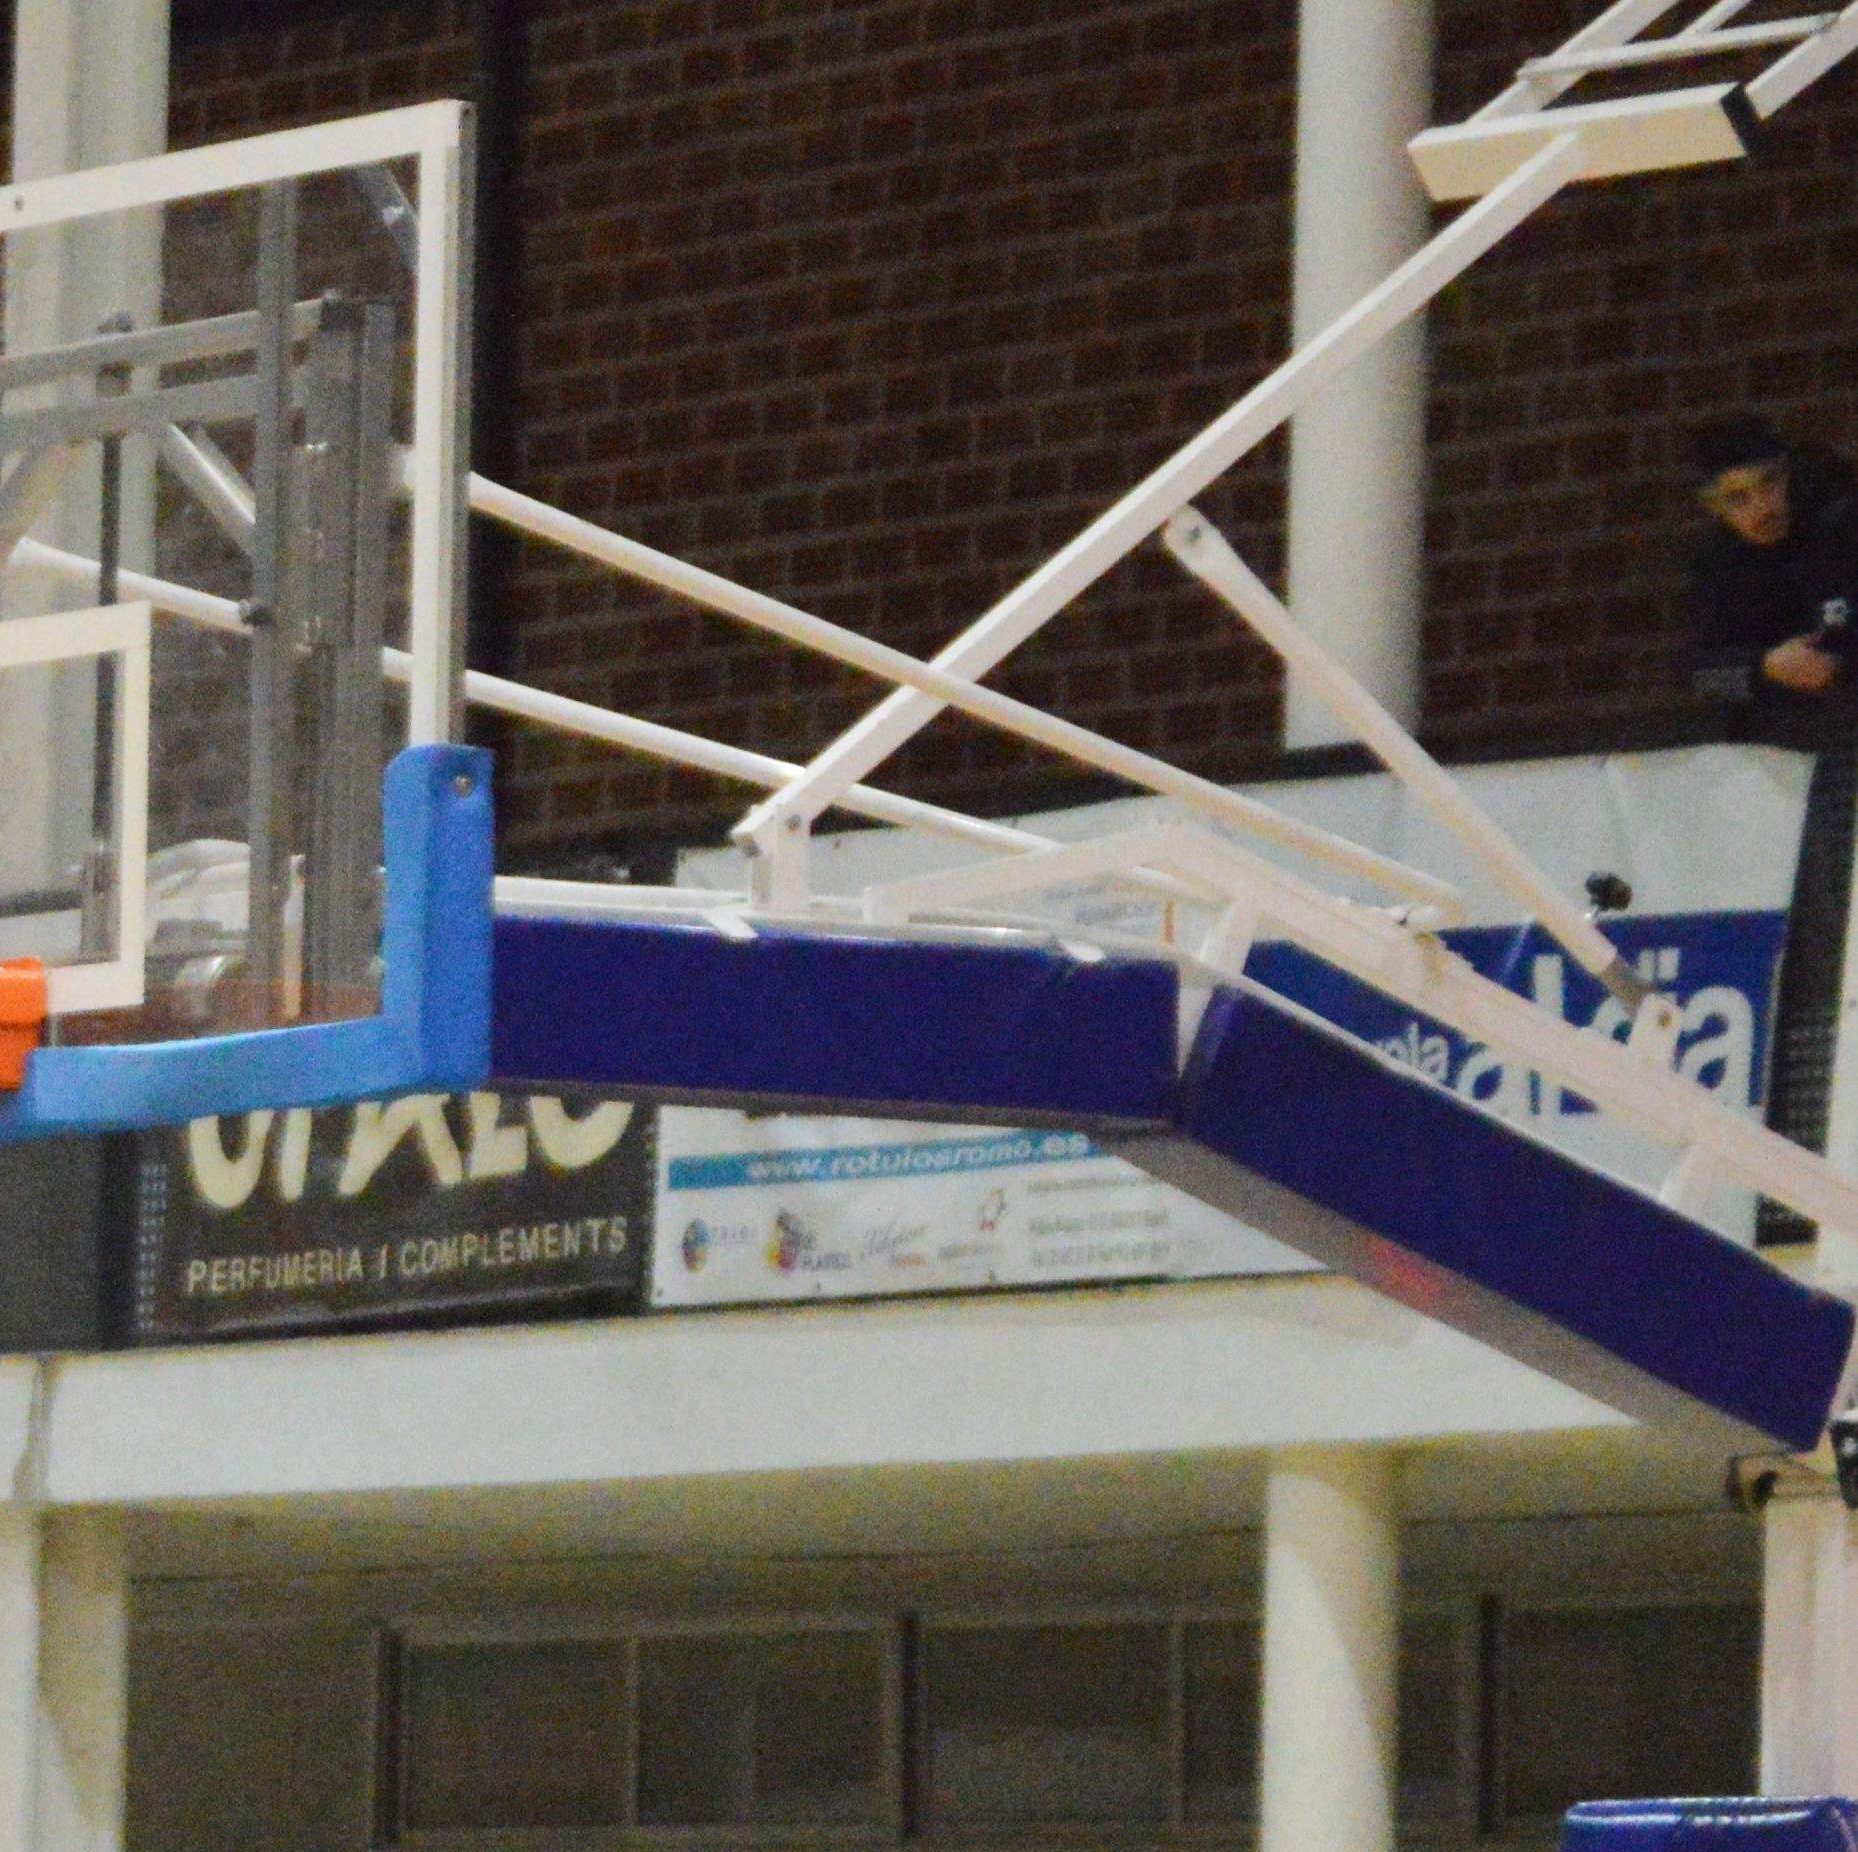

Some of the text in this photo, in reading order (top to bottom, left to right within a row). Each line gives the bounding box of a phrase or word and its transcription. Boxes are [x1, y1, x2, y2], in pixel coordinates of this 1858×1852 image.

[1374, 1022, 1448, 1082] ola
[185, 1246, 363, 1295] PERFUMERIA
[398, 1215, 628, 1277] COMPLEMENTS
